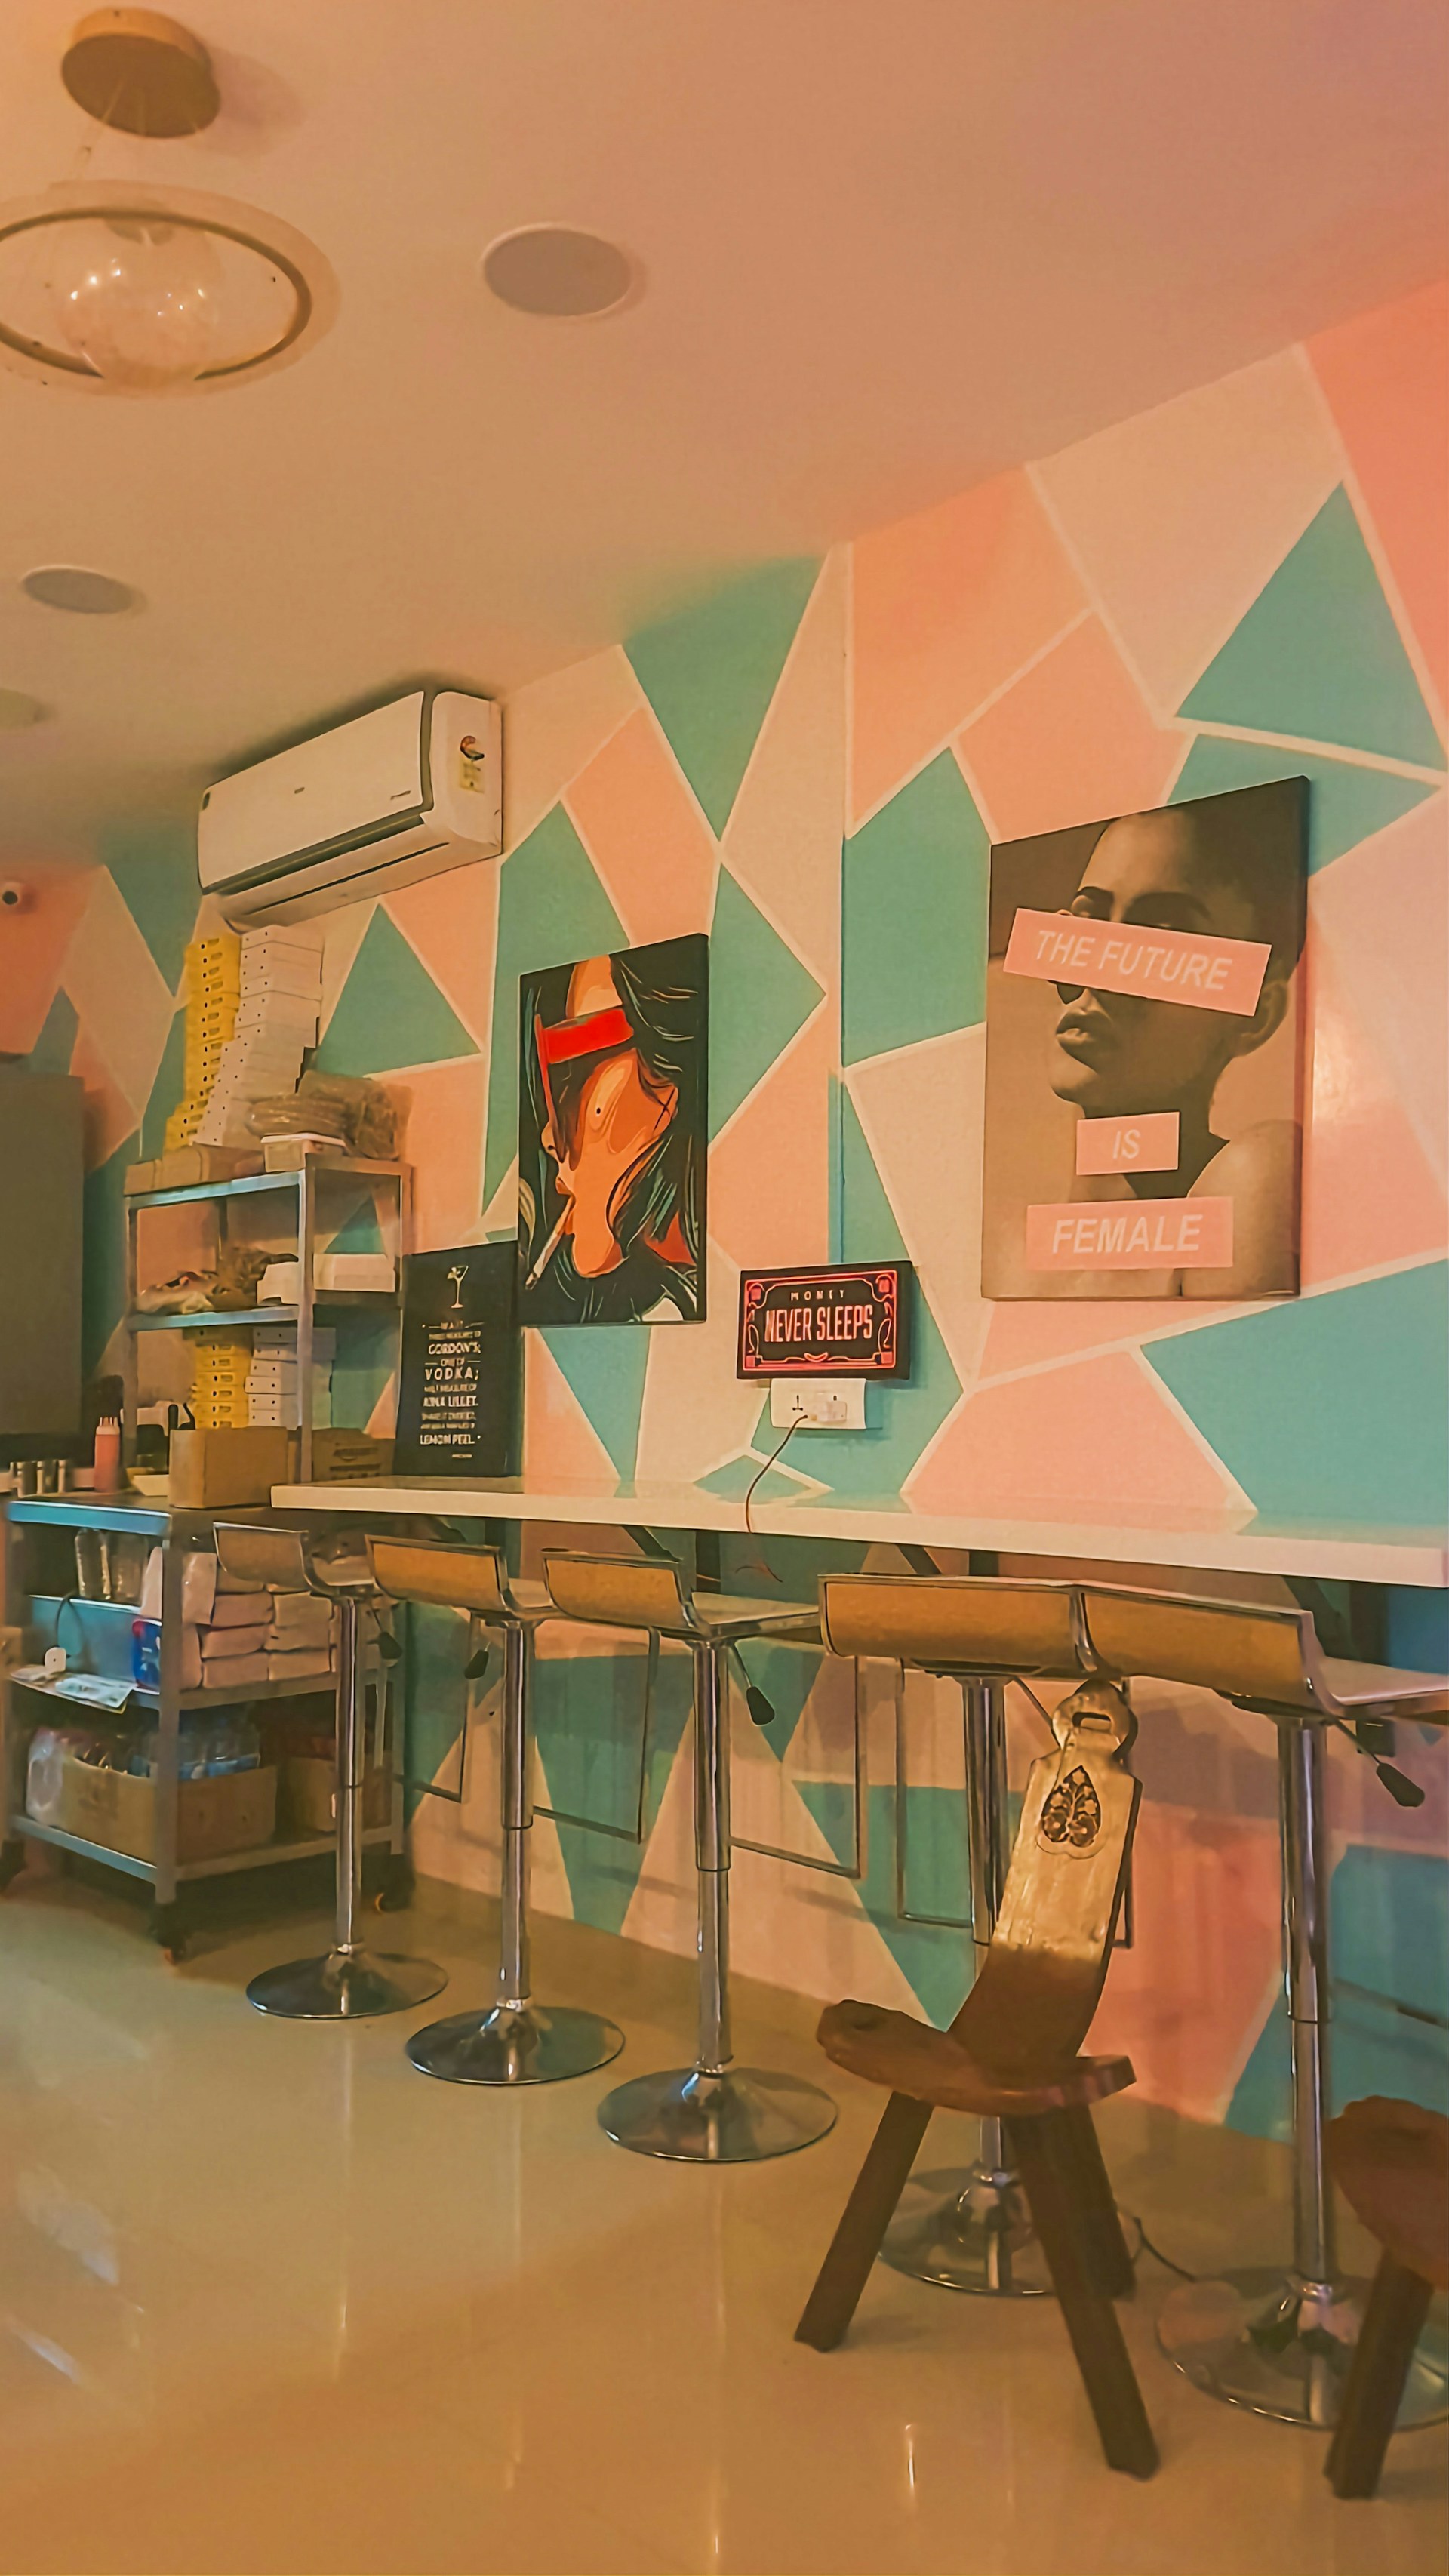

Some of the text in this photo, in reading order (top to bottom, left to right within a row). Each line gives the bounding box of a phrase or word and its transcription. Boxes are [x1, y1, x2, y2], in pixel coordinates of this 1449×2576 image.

[1036, 930, 1232, 991] THE FUTURE
[1112, 1129, 1141, 1159] IS
[1052, 1214, 1204, 1254] FEMALE
[790, 1289, 845, 1301] MONEY
[764, 1304, 873, 1342] NEVER SLEEPS
